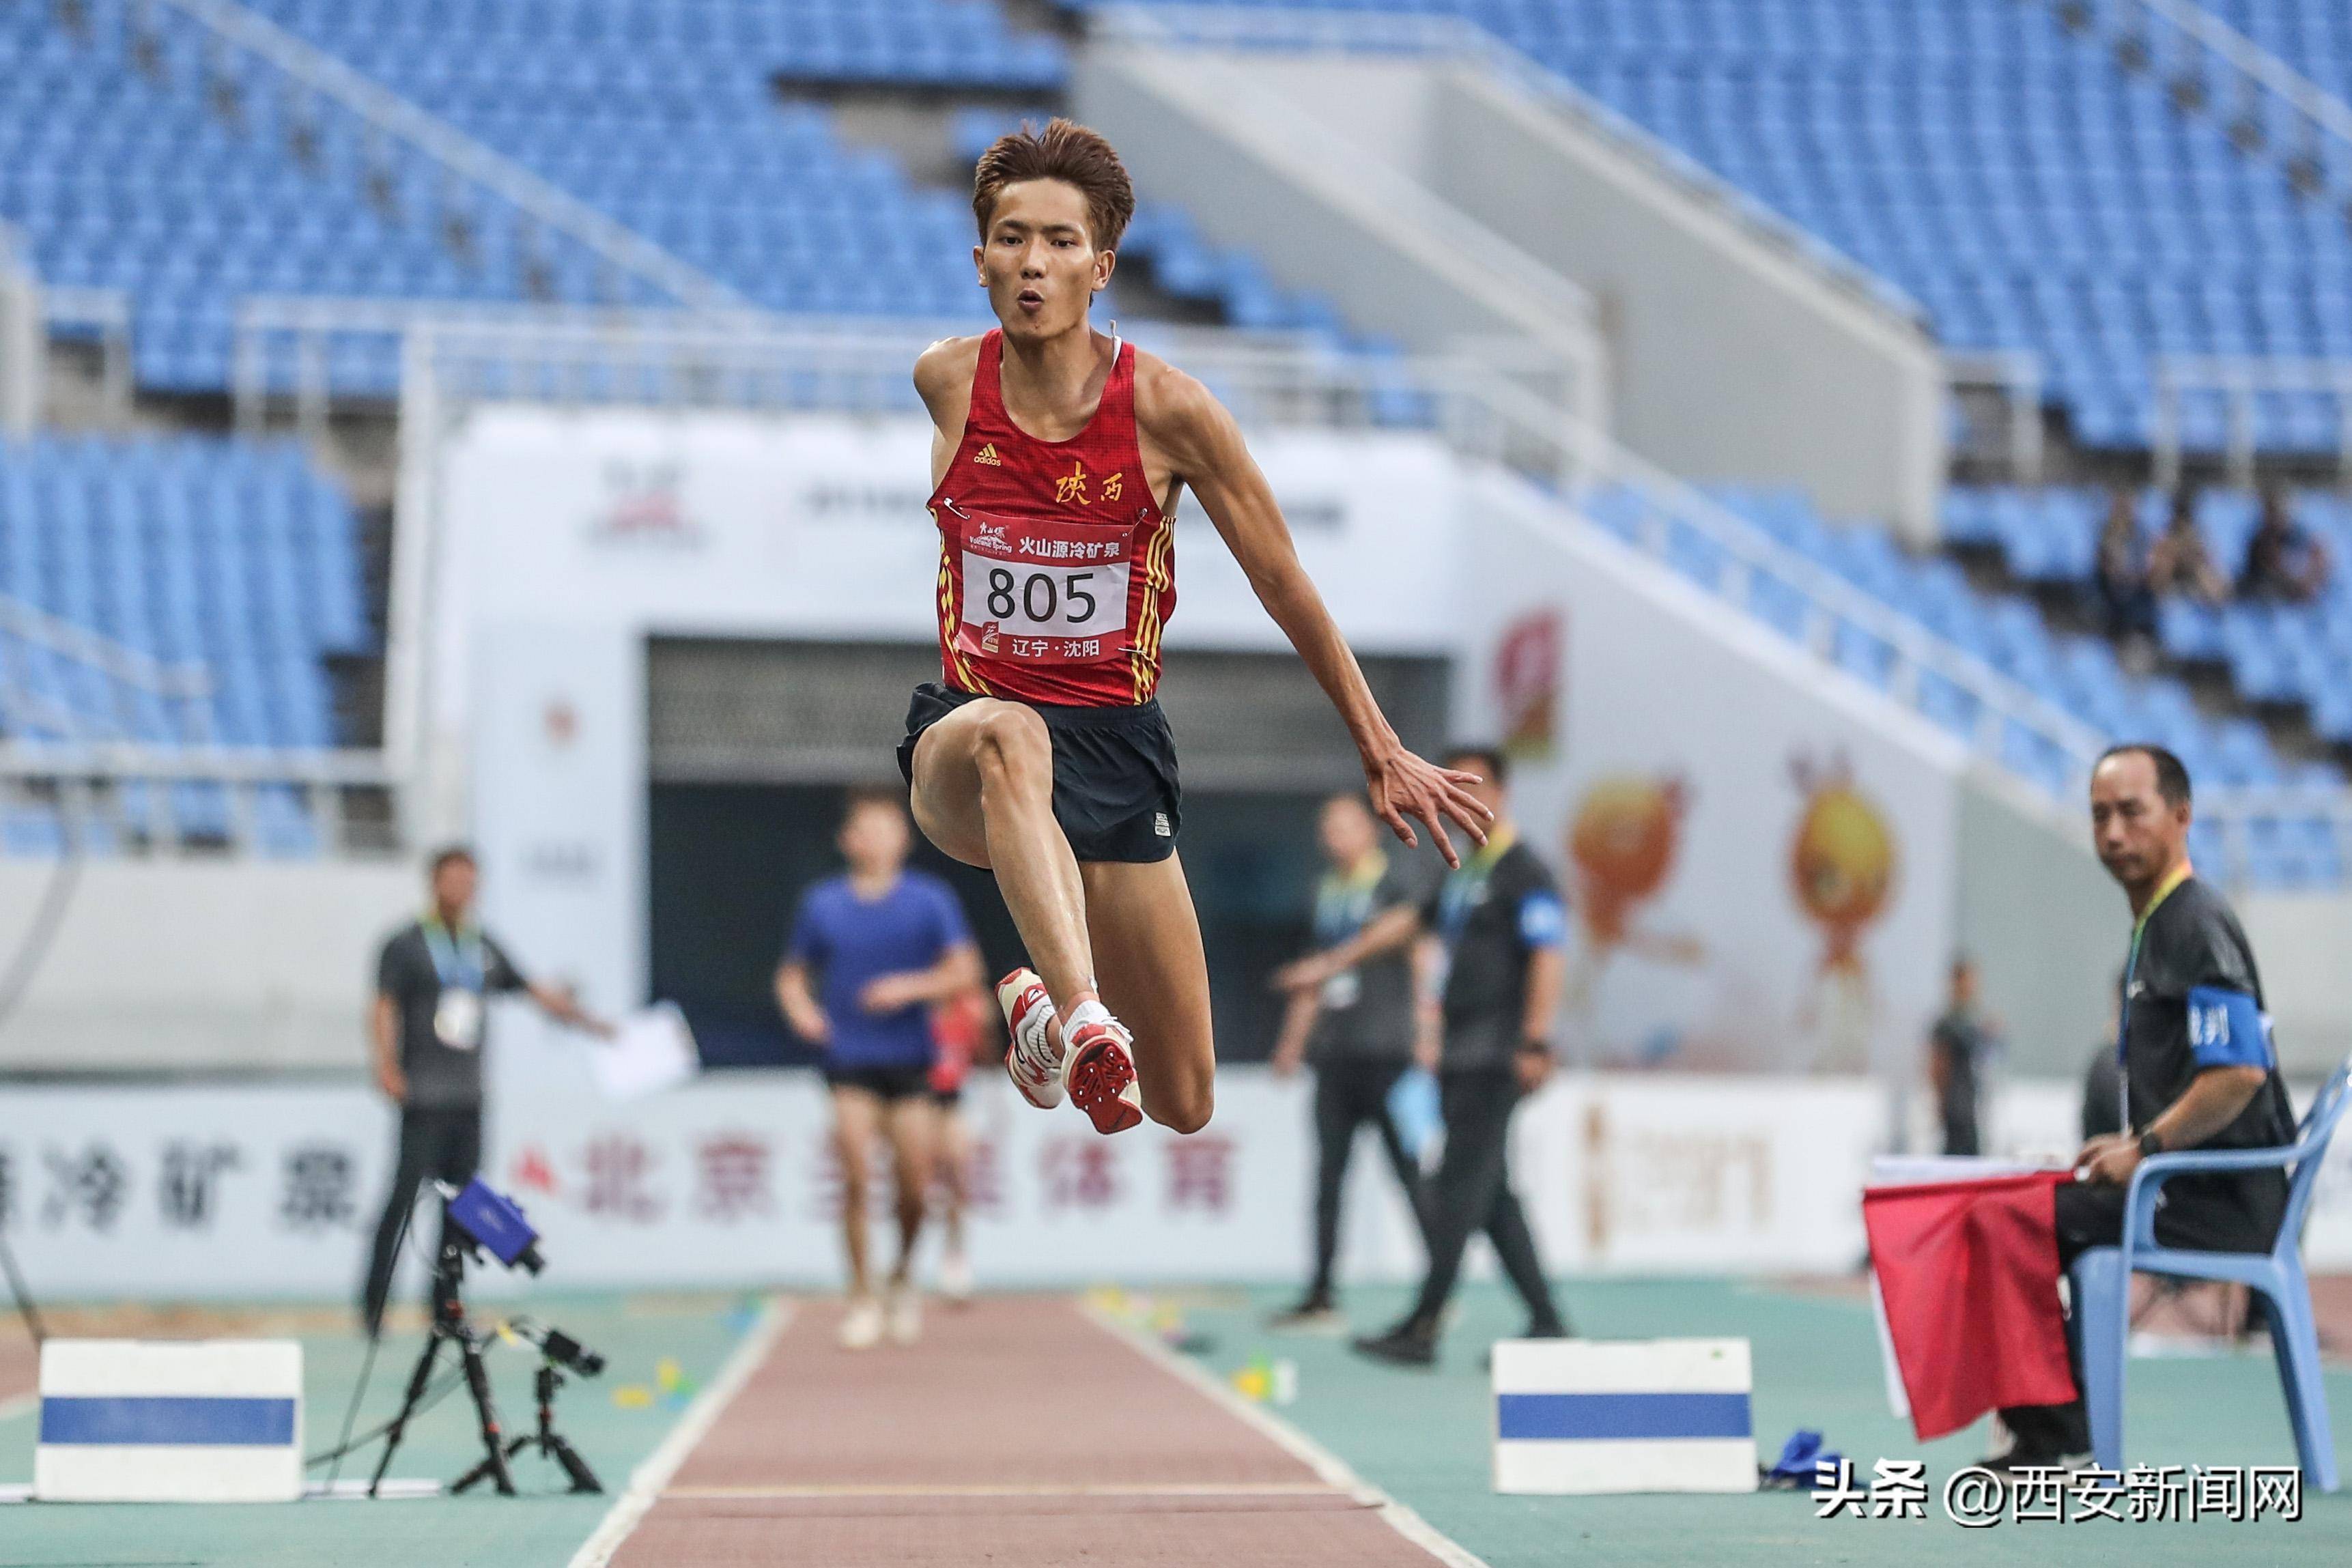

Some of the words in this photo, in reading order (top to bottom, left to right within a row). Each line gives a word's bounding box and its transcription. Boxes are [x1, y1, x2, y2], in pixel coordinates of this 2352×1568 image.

[974, 456, 1001, 466] adidas
[1055, 460, 1122, 505] 陕西
[969, 535, 992, 548] Volcanic
[992, 541, 1012, 554] Spring
[1018, 536, 1120, 560] 火山源冷矿泉
[987, 567, 1096, 623] 805
[1012, 639, 1100, 658] 辽宁·沈阳
